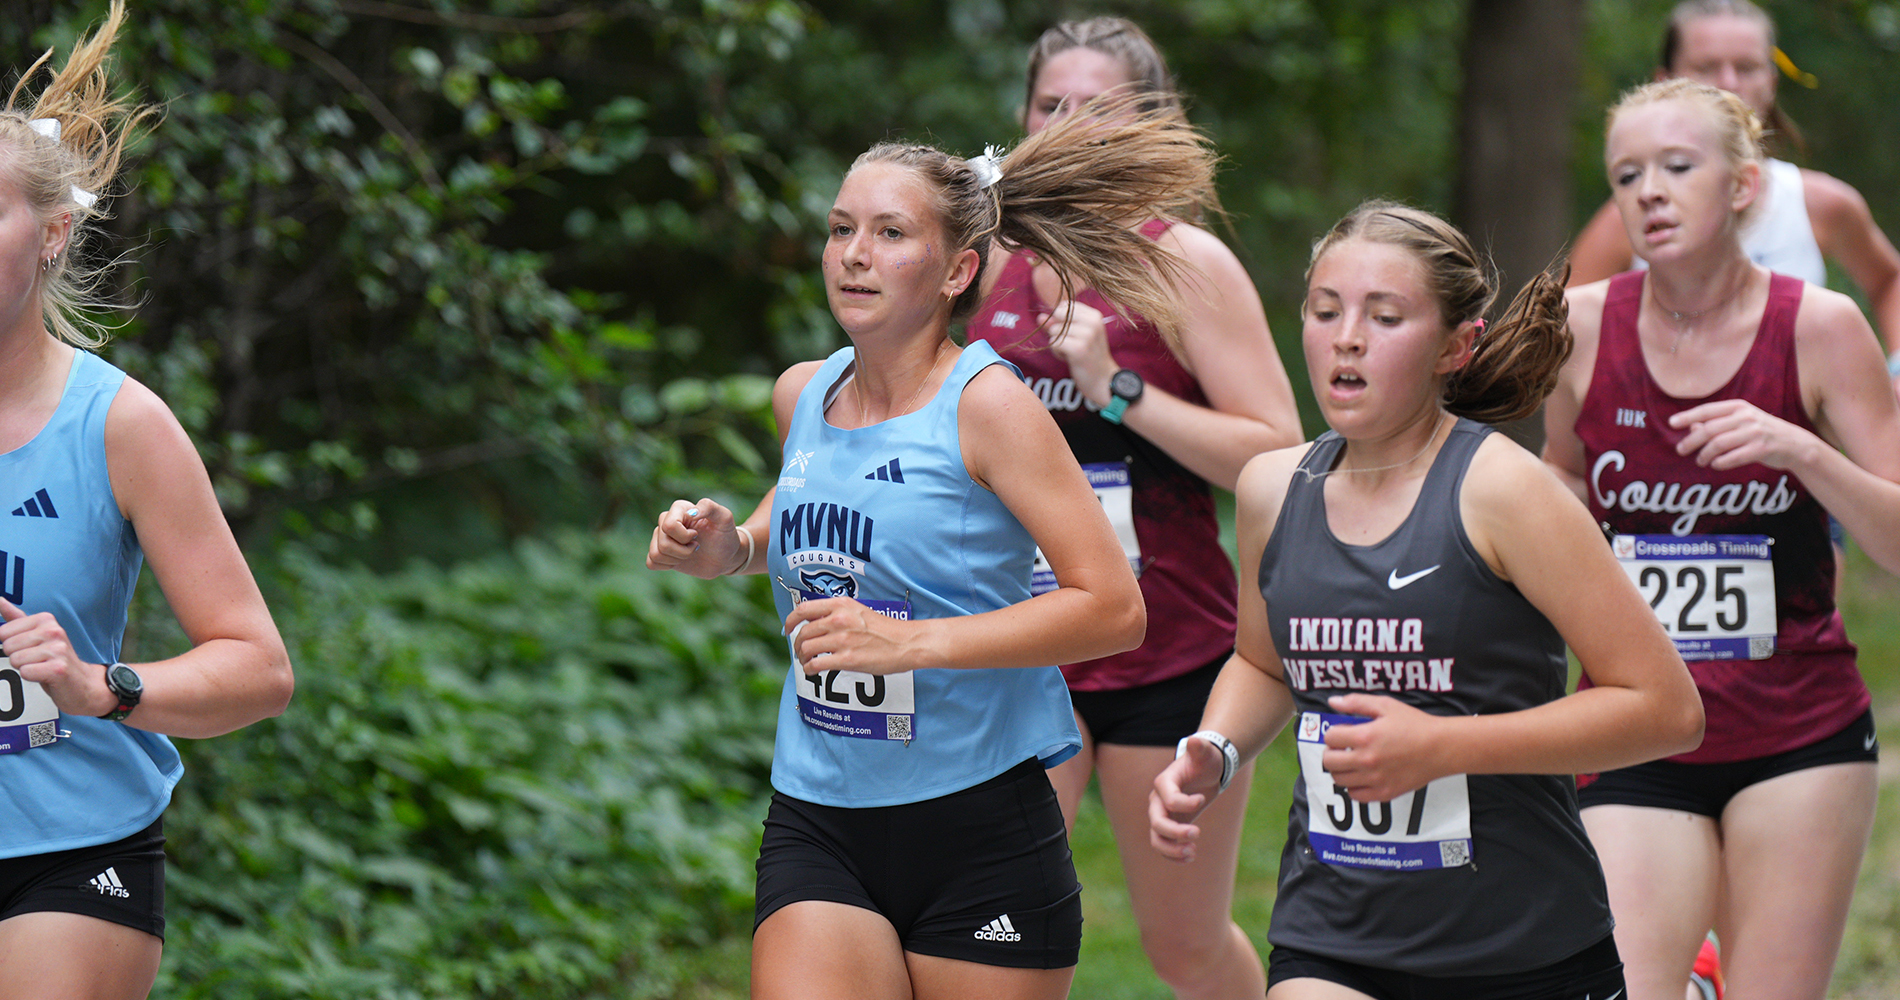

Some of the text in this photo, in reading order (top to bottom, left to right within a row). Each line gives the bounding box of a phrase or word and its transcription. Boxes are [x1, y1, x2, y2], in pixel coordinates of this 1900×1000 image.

[1616, 408, 1646, 428] IUK
[1592, 450, 1797, 536] Cougars
[780, 502, 874, 563] MVNU
[1636, 541, 1769, 558] Crossroads Timing
[792, 553, 856, 570] COUGARS
[1639, 566, 1749, 633] 225
[1289, 617, 1424, 652] INDIANA
[1282, 657, 1455, 692] WESLEYAN
[813, 706, 851, 722] Live Results at
[1341, 841, 1397, 855] Live Results at
[974, 930, 1021, 942] adidas
